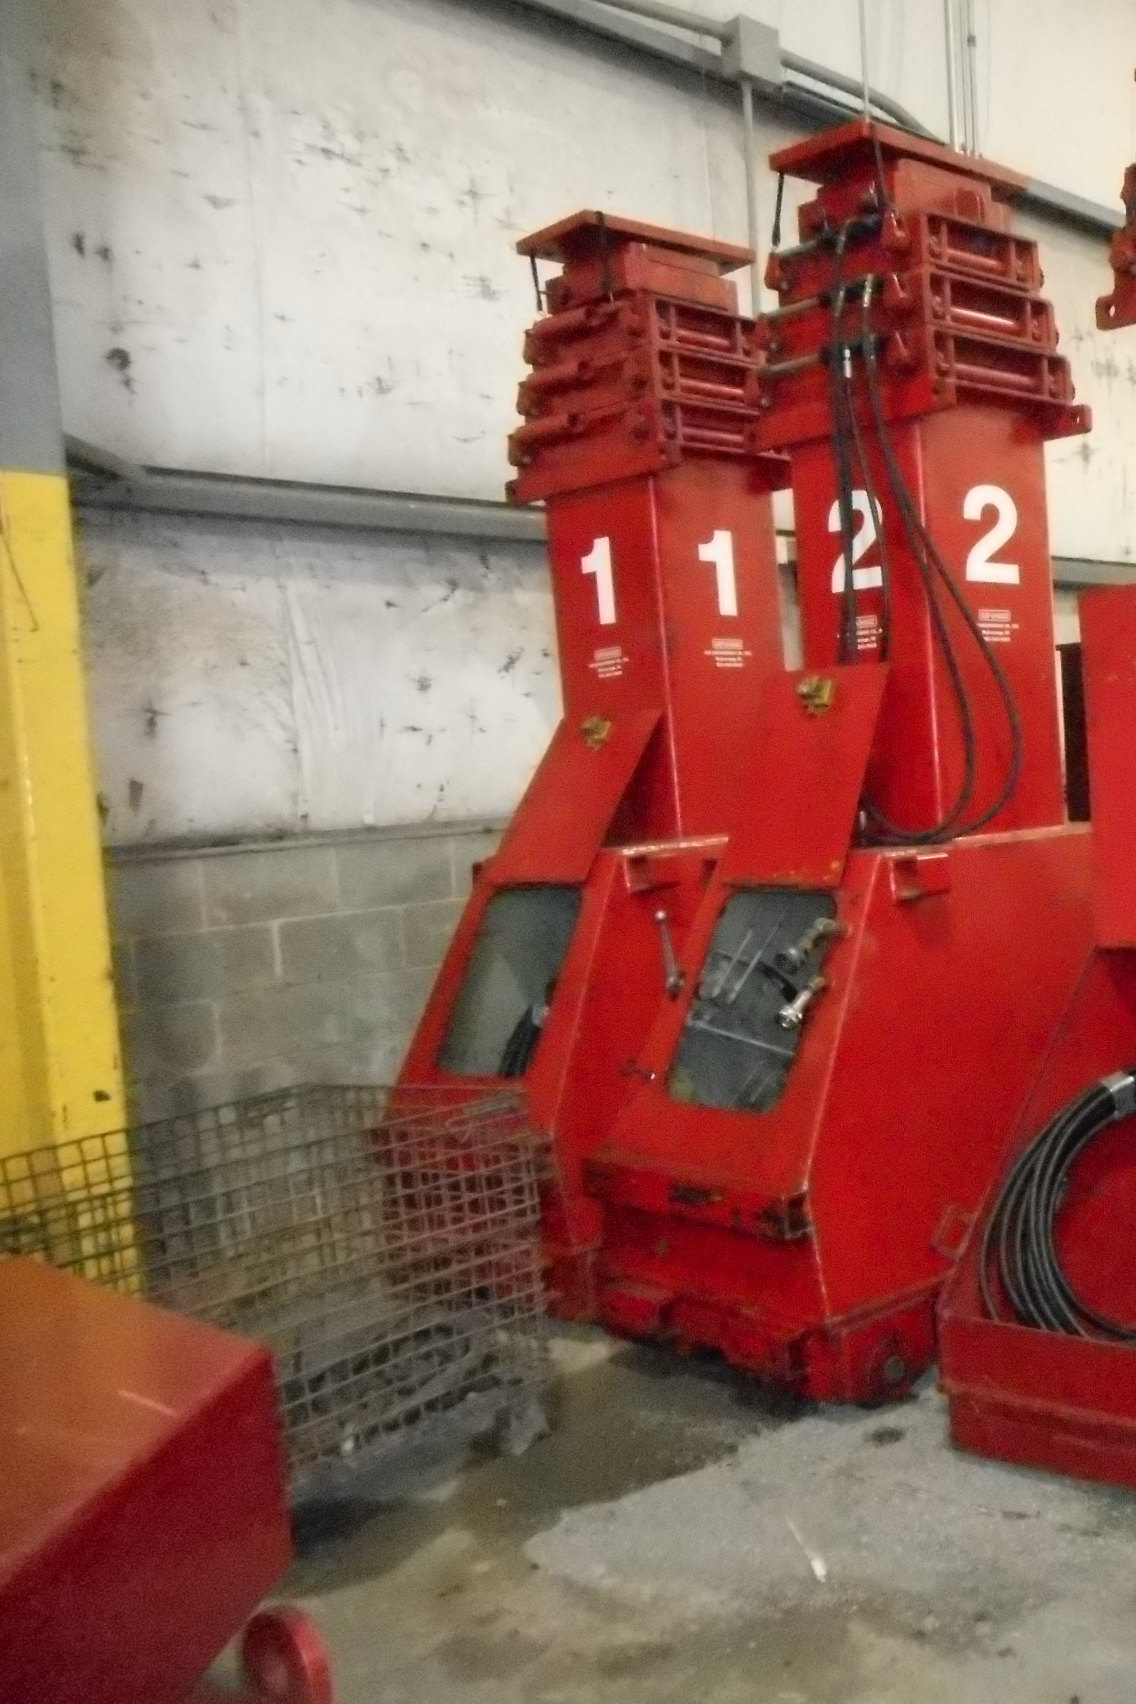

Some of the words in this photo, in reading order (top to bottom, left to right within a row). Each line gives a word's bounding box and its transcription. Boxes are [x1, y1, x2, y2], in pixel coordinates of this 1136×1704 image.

[580, 536, 617, 625] 1
[697, 529, 738, 617] 1
[828, 489, 884, 594] 2
[962, 484, 1020, 585] 2
